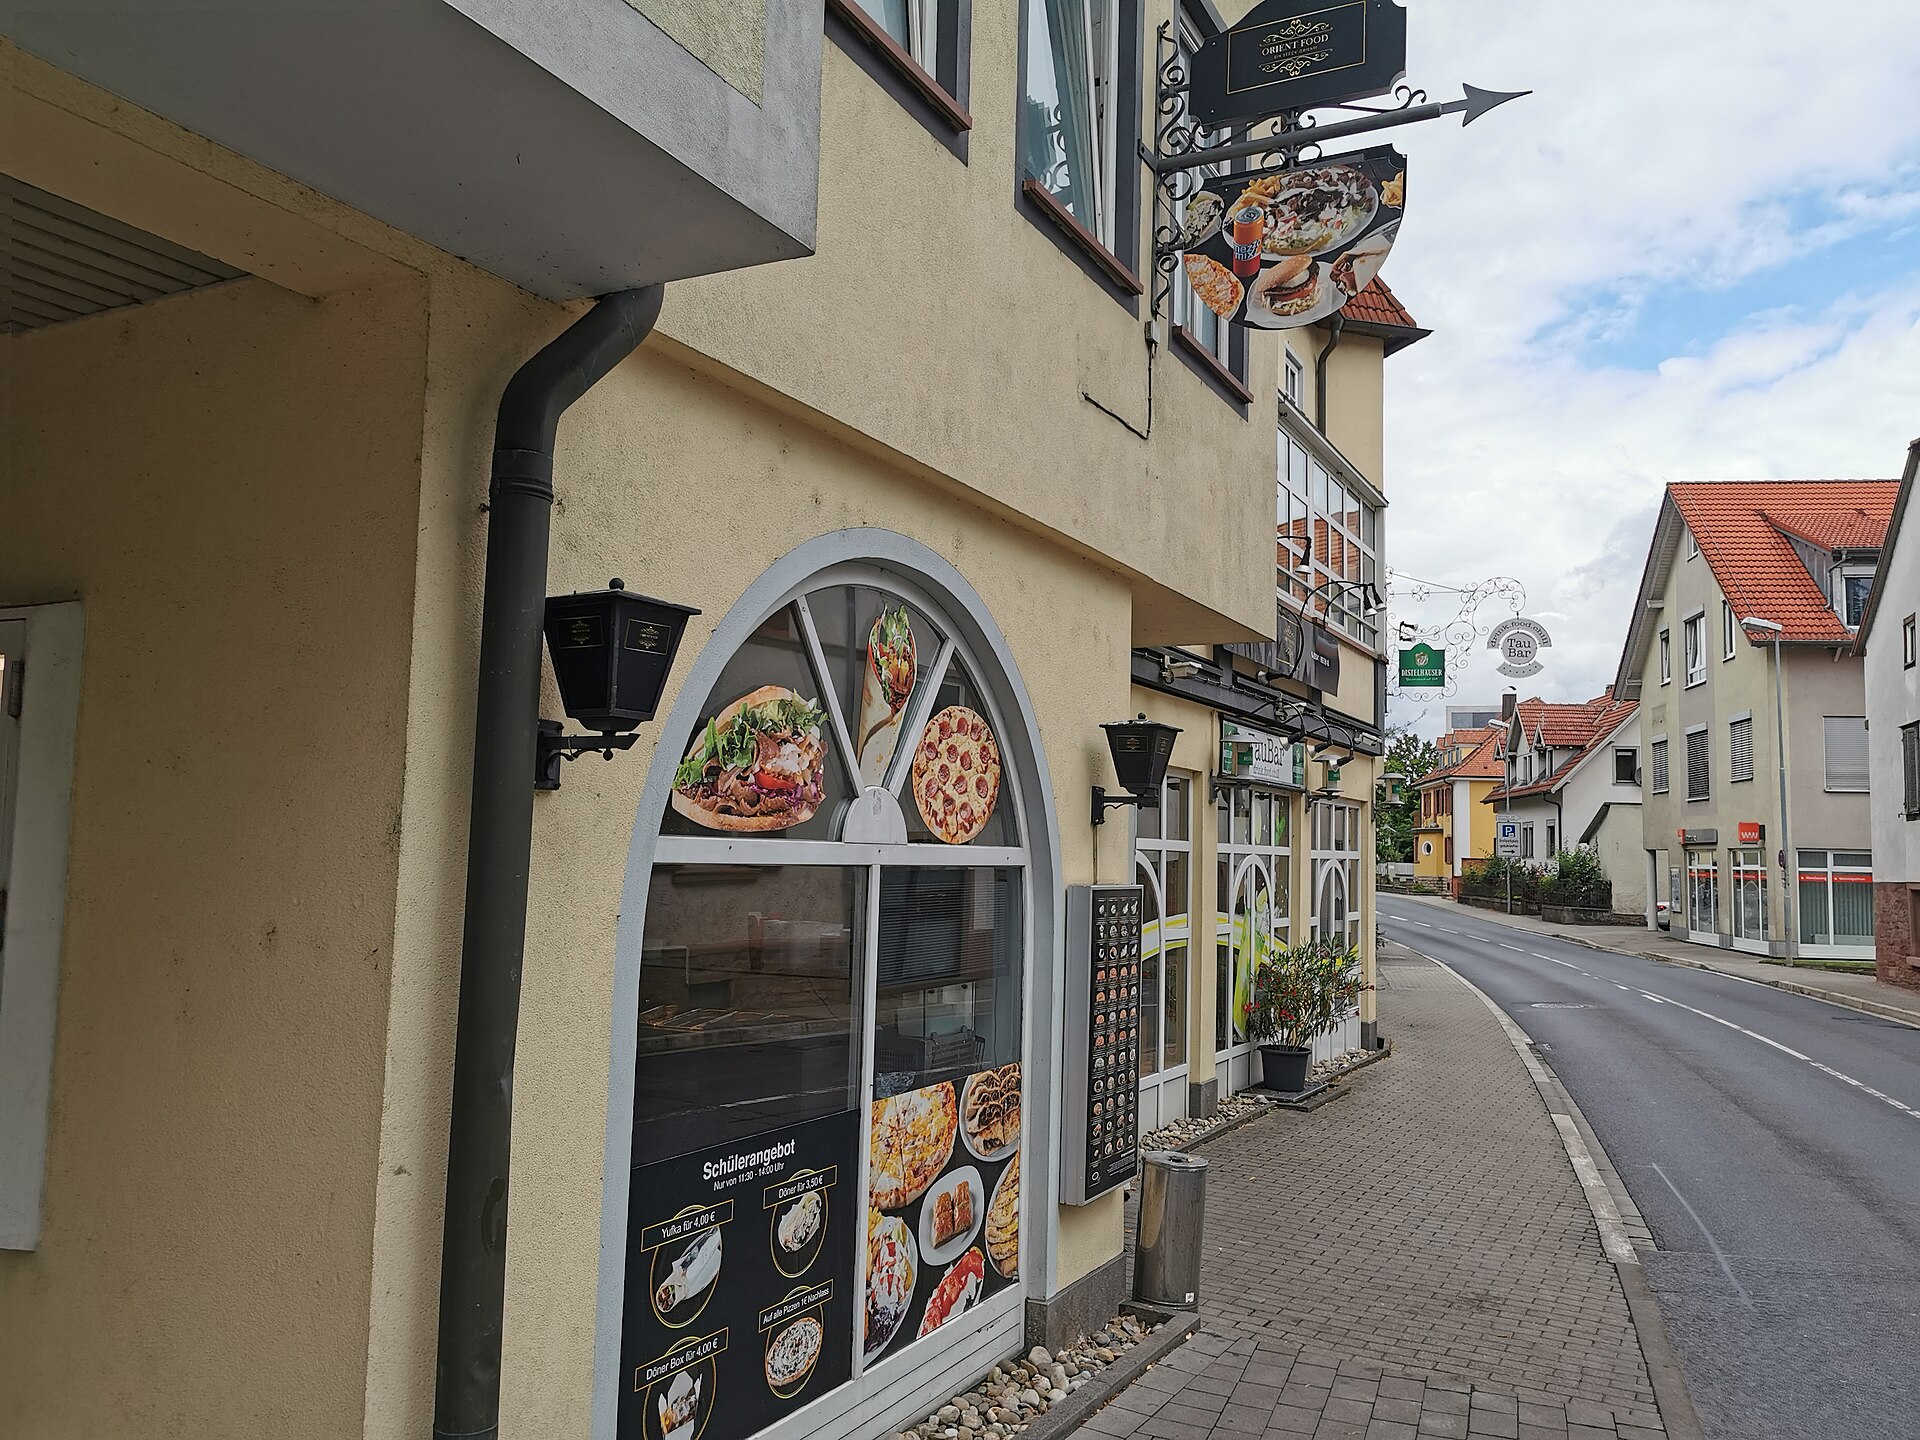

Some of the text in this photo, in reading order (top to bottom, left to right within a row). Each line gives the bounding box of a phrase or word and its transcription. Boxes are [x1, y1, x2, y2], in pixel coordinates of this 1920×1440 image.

[1261, 33, 1329, 56] ORIENT FOOD
[1507, 638, 1531, 648] Tau
[1507, 647, 1531, 658] Bar
[1253, 738, 1285, 766] auBar
[702, 1138, 796, 1181] Schülerangebot
[713, 1180, 725, 1192] Nur
[725, 1177, 737, 1188] von
[738, 1170, 753, 1184] 11:30
[758, 1164, 773, 1178] 14:00
[774, 1161, 785, 1173] Uhr
[778, 1184, 796, 1199] Döner
[796, 1179, 806, 1193] für
[805, 1177, 819, 1190] 3,50
[661, 1210, 716, 1239] Yufka für 4,00 €
[762, 1311, 773, 1325] Auf
[772, 1308, 783, 1320] alle
[783, 1301, 800, 1315] Pizzen
[807, 1287, 830, 1304] Nachlass
[646, 1337, 718, 1381] Döner Box für 4,00 €
